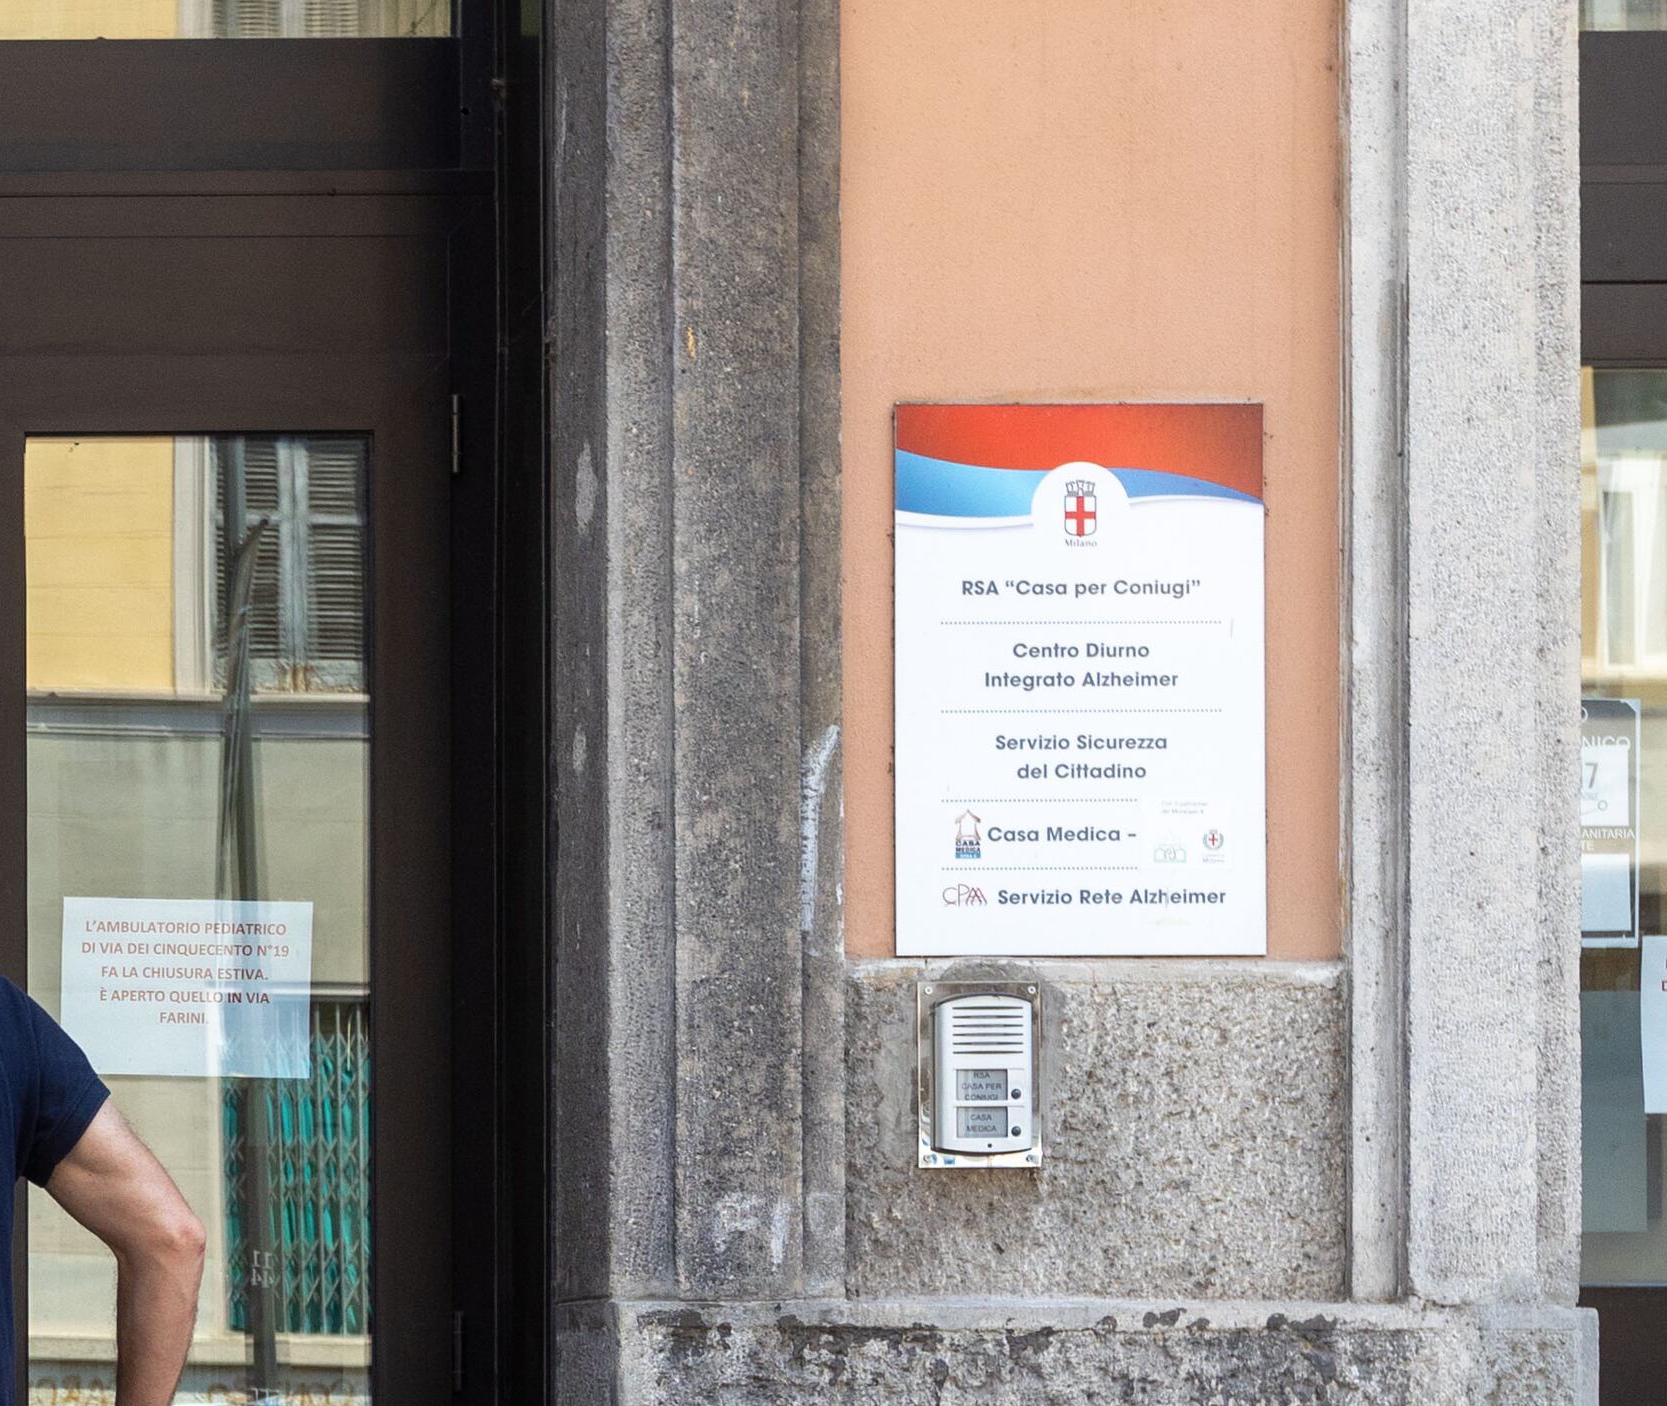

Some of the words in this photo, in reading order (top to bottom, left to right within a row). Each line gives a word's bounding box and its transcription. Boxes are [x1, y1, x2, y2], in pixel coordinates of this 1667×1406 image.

[1064, 538, 1098, 548] Milano
[961, 580, 1000, 596] RSA
[1005, 579, 1068, 597] “Casa
[1073, 583, 1107, 601] per
[1113, 578, 1201, 600] Coniugi”
[1012, 642, 1080, 659] Centro
[1085, 642, 1150, 659] Diurno
[984, 671, 1075, 691] Integrato
[1081, 671, 1179, 688] Alzheimer
[995, 734, 1070, 751] Servizio
[1076, 734, 1168, 751] Sicurezza
[1016, 763, 1049, 779] del
[1054, 762, 1147, 780] Cittadino
[987, 826, 1042, 843] Casa
[1047, 825, 1121, 843] Medica
[1581, 828, 1635, 840] ANITARIA
[997, 889, 1073, 905] Servizio
[1079, 888, 1124, 905] Rete
[1129, 887, 1227, 905] Alzheimer
[85, 919, 201, 934] L'AMBULATORIO
[203, 922, 287, 937] PEDIATRICO
[81, 941, 97, 954] DI
[99, 942, 124, 955] VIA
[127, 942, 150, 955] DEI
[153, 942, 254, 958] CINQUECENTO
[101, 966, 118, 978] FA
[122, 966, 139, 979] LA
[142, 966, 214, 980] CHIUSURA
[217, 968, 269, 981] ESTIVA.
[99, 986, 107, 1001] È
[111, 989, 166, 1002] APERTO
[169, 990, 223, 1005] QUELLO
[227, 991, 243, 1004] IN
[246, 992, 271, 1004] VIA
[961, 1082, 984, 1090] CASA
[970, 1113, 992, 1121] CASA
[966, 1124, 997, 1132] MEDICA
